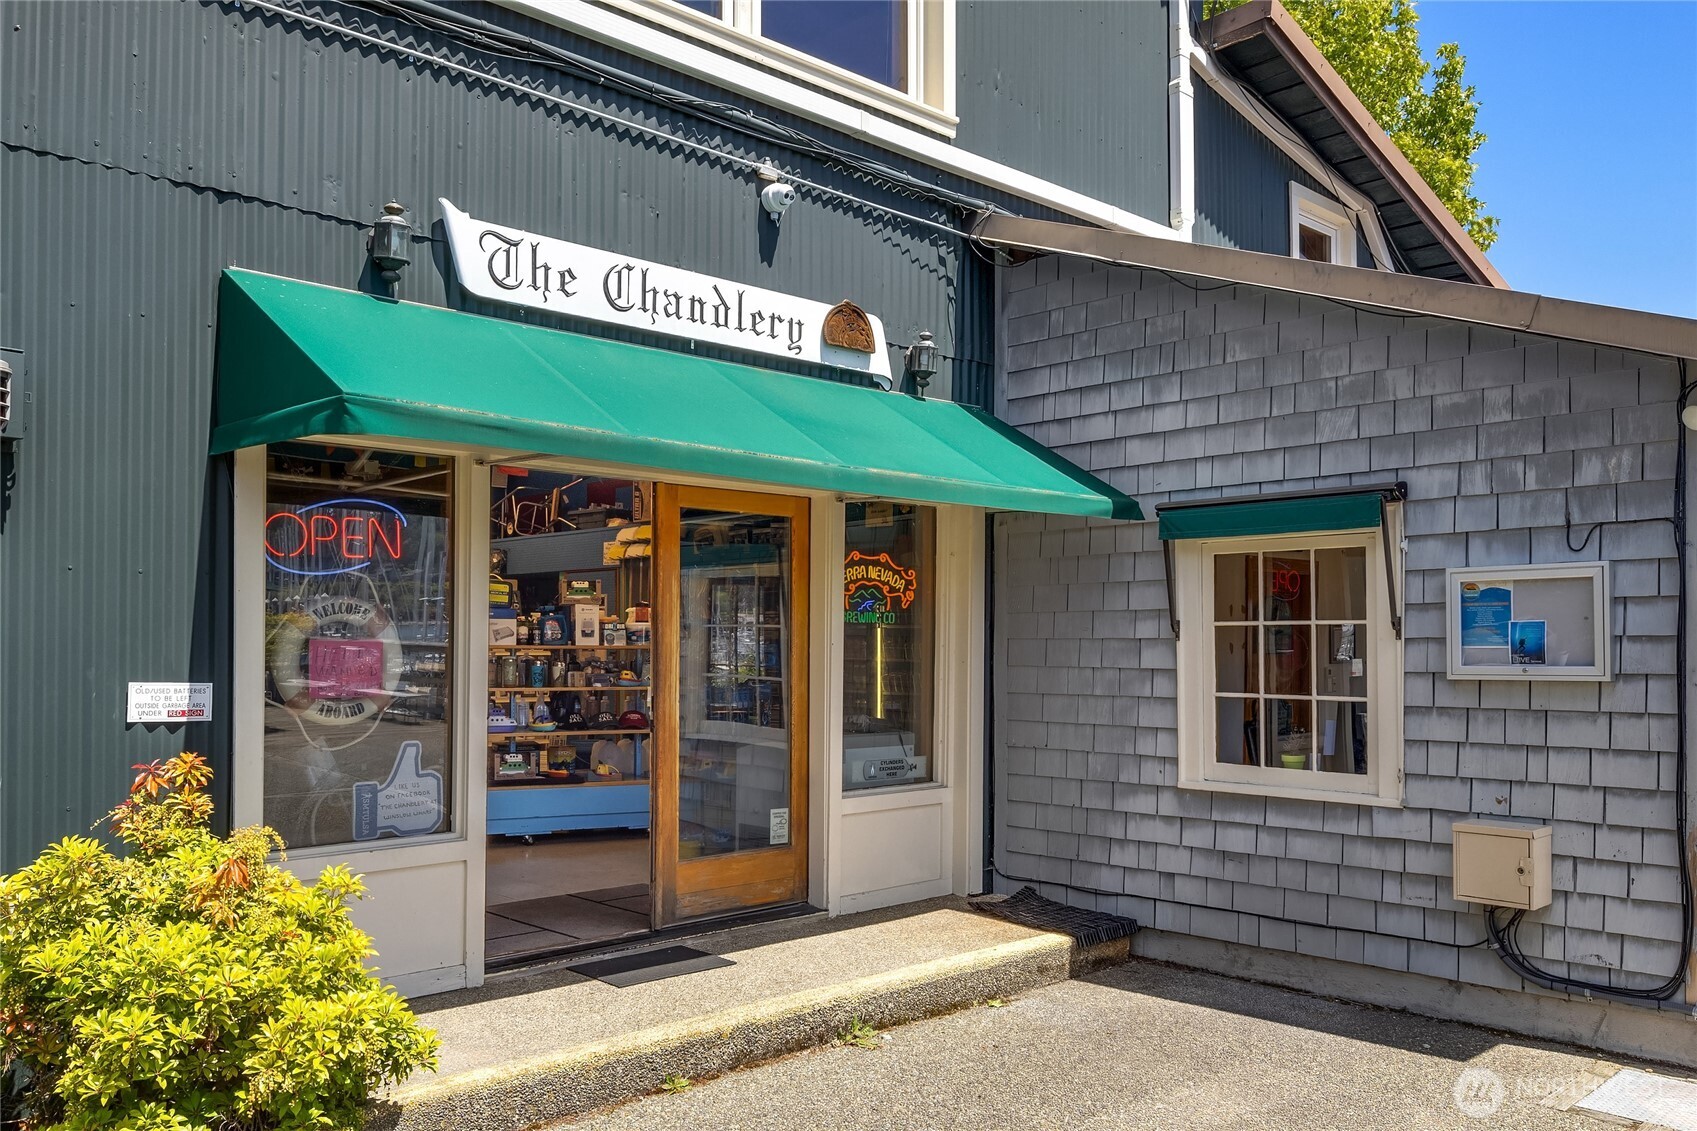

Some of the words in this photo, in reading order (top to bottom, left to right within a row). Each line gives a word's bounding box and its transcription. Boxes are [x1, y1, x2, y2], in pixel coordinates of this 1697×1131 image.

[479, 229, 578, 304] The
[603, 263, 804, 355] Chandlery
[265, 512, 401, 559] OPEN
[868, 565, 906, 593] NEVADA
[312, 602, 371, 621] WELCOME
[883, 612, 895, 624] CO
[316, 702, 365, 719] ABOARD
[397, 790, 431, 799] FACEBOOK
[383, 812, 412, 820] WINSLOW
